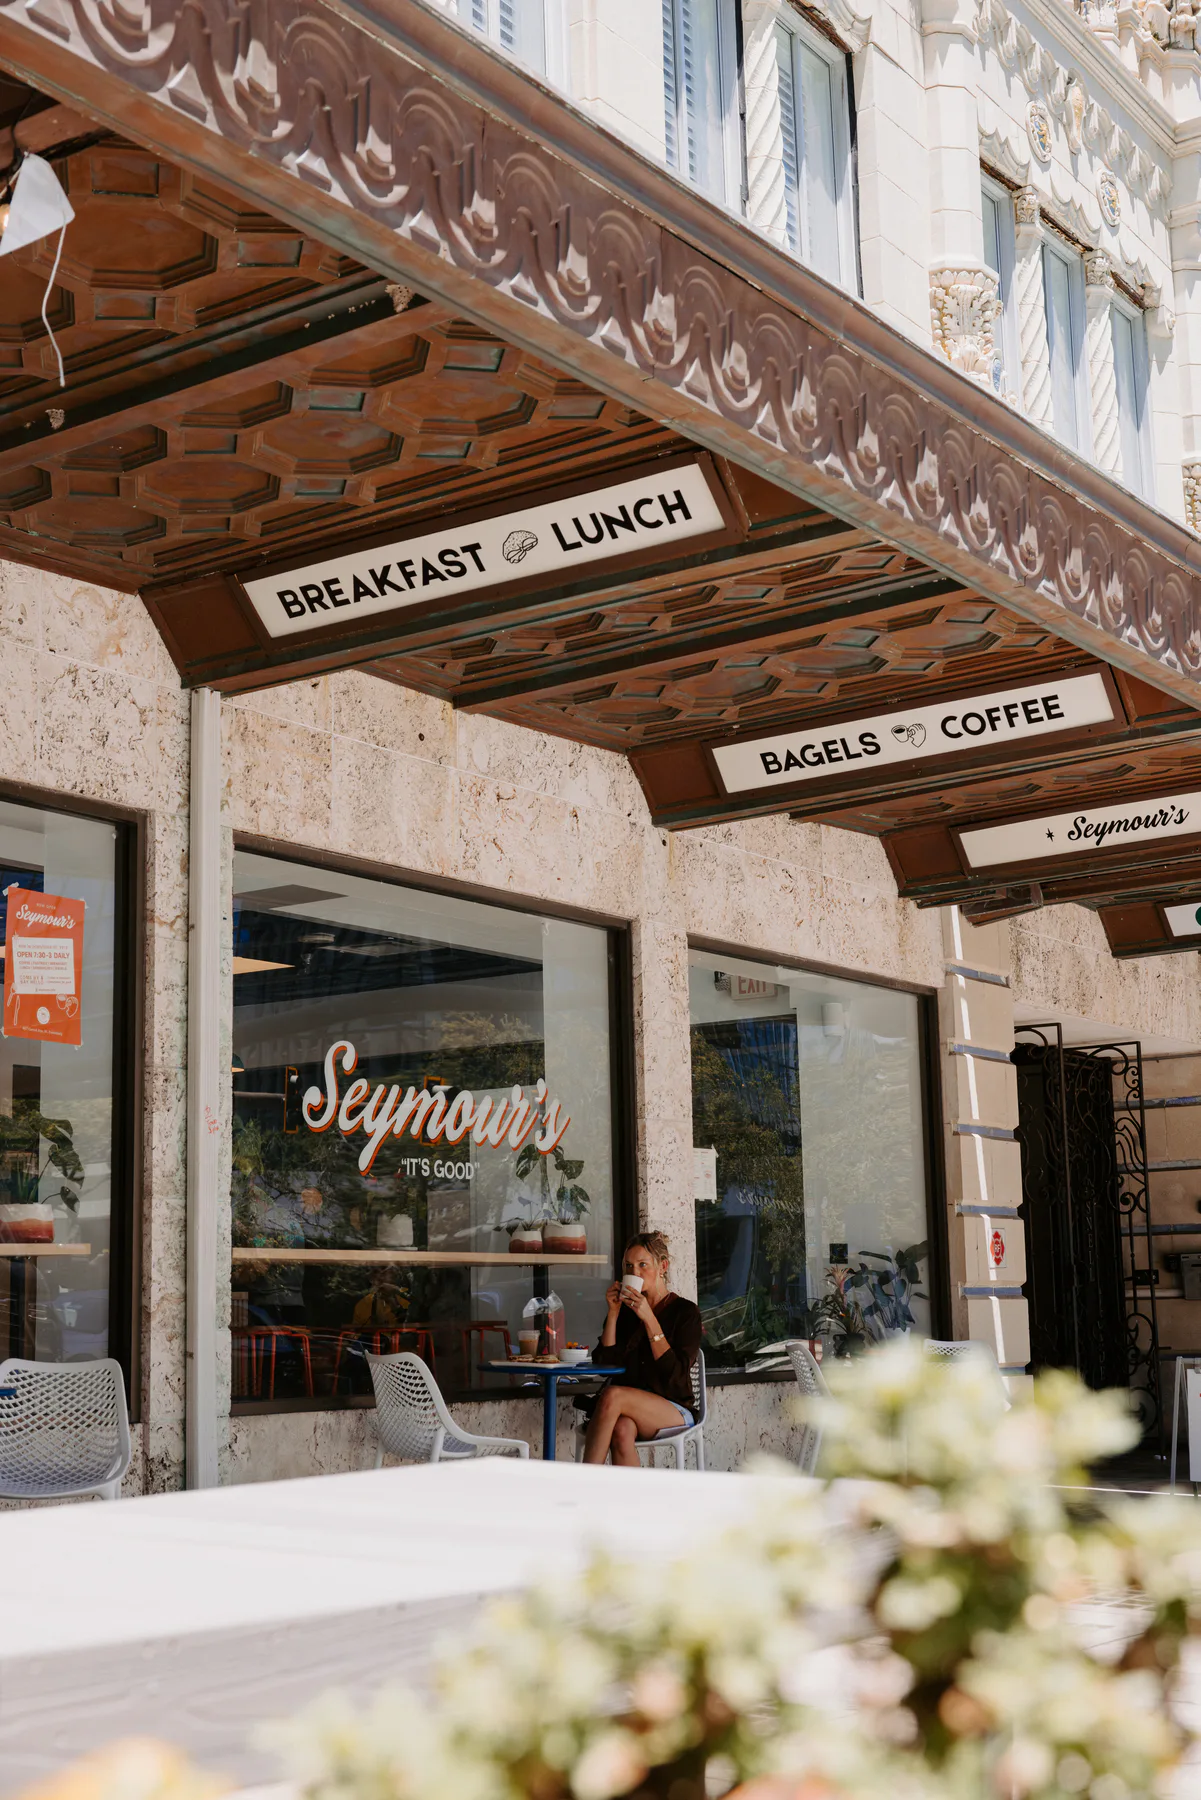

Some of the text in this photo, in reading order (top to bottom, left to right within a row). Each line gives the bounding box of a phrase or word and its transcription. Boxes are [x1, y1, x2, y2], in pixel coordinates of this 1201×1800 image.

[277, 489, 693, 619] BREAKFAST LUNCH
[759, 694, 1065, 775] BAGELS COFFEE
[1067, 804, 1190, 846] Seymour's
[16, 903, 76, 929] Seymour's
[302, 1040, 570, 1176] Seymour's
